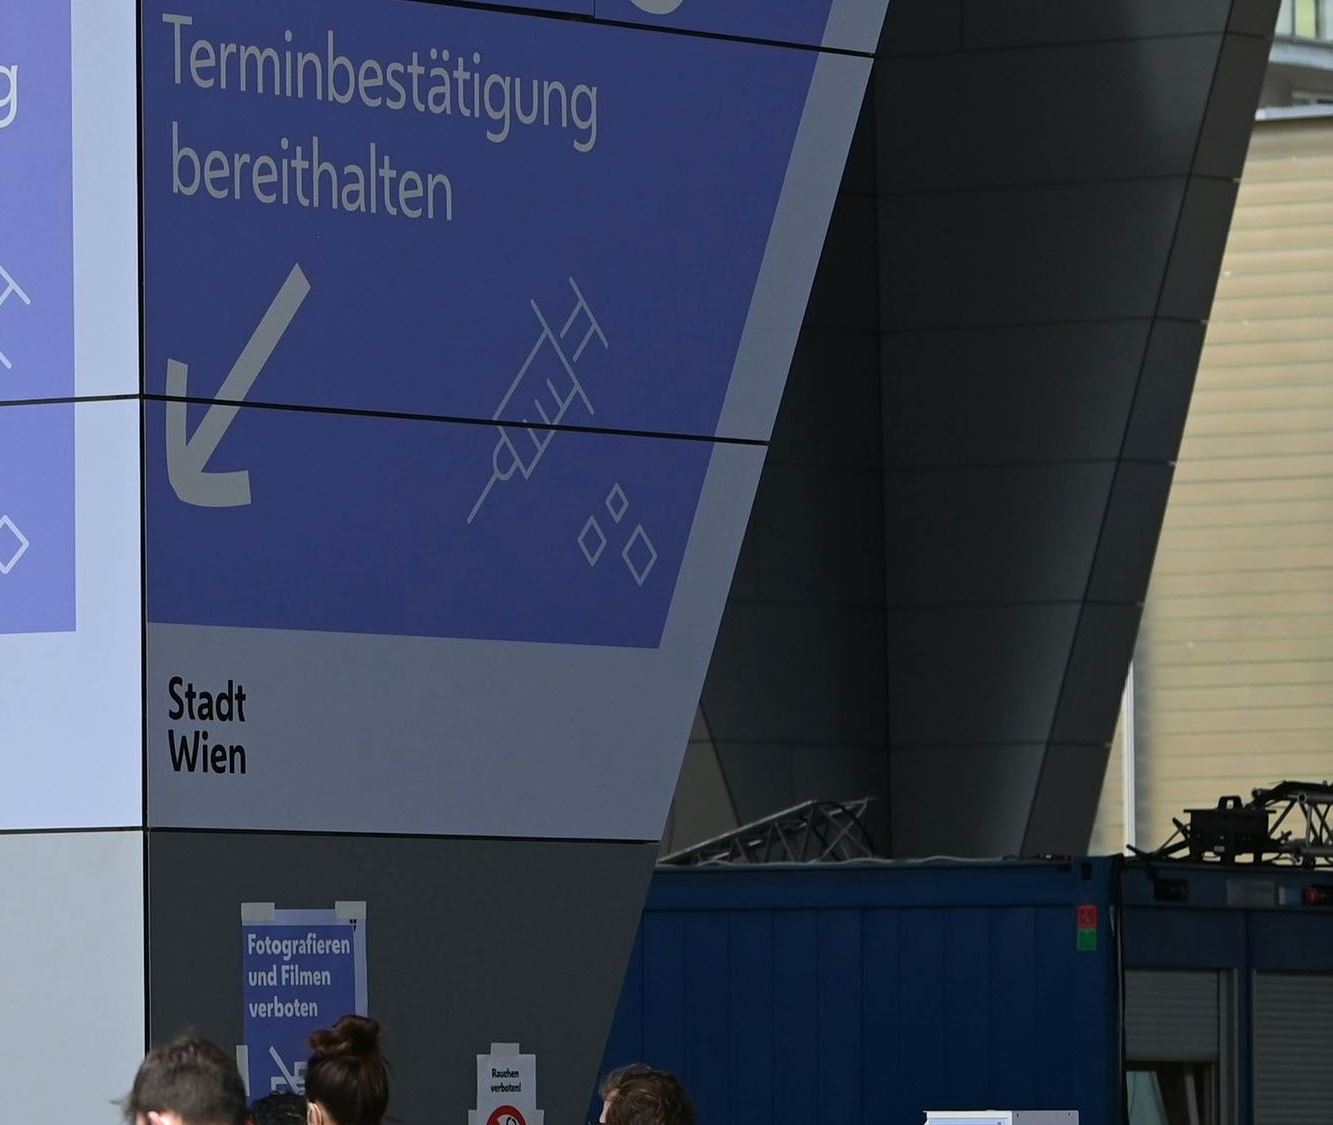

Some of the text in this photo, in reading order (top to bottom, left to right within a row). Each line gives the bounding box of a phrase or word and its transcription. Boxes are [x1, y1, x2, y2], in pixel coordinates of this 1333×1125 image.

[162, 13, 598, 152] Terminbestätigung
[172, 121, 453, 221] bereithalten
[168, 676, 246, 722] Stadt
[168, 729, 246, 774] Wien
[247, 932, 351, 961] Fotografieren
[248, 964, 331, 986] und Filmen
[249, 996, 318, 1018] verboten
[490, 1082, 522, 1093] verboten!
[491, 1068, 520, 1078] Rauchen
